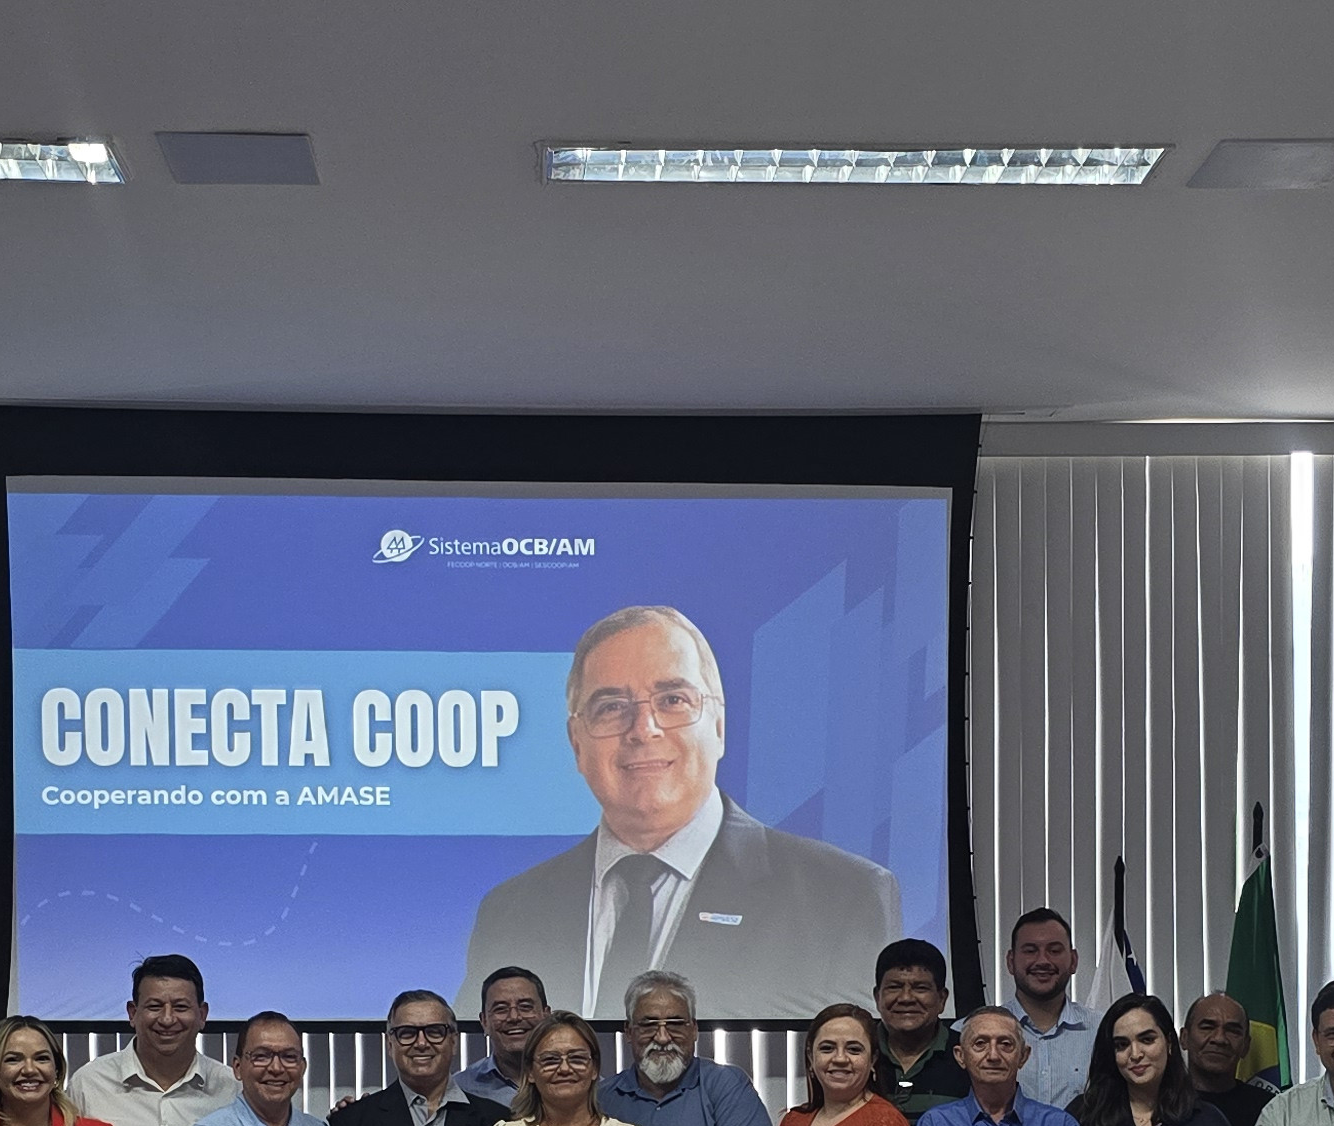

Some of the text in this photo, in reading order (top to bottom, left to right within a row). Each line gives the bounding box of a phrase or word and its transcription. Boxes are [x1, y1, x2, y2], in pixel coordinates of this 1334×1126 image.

[429, 537, 595, 556] SistemaOCB/AM
[41, 687, 520, 768] CONECTA COOP
[41, 785, 391, 810] Cooperando com a AMASE
